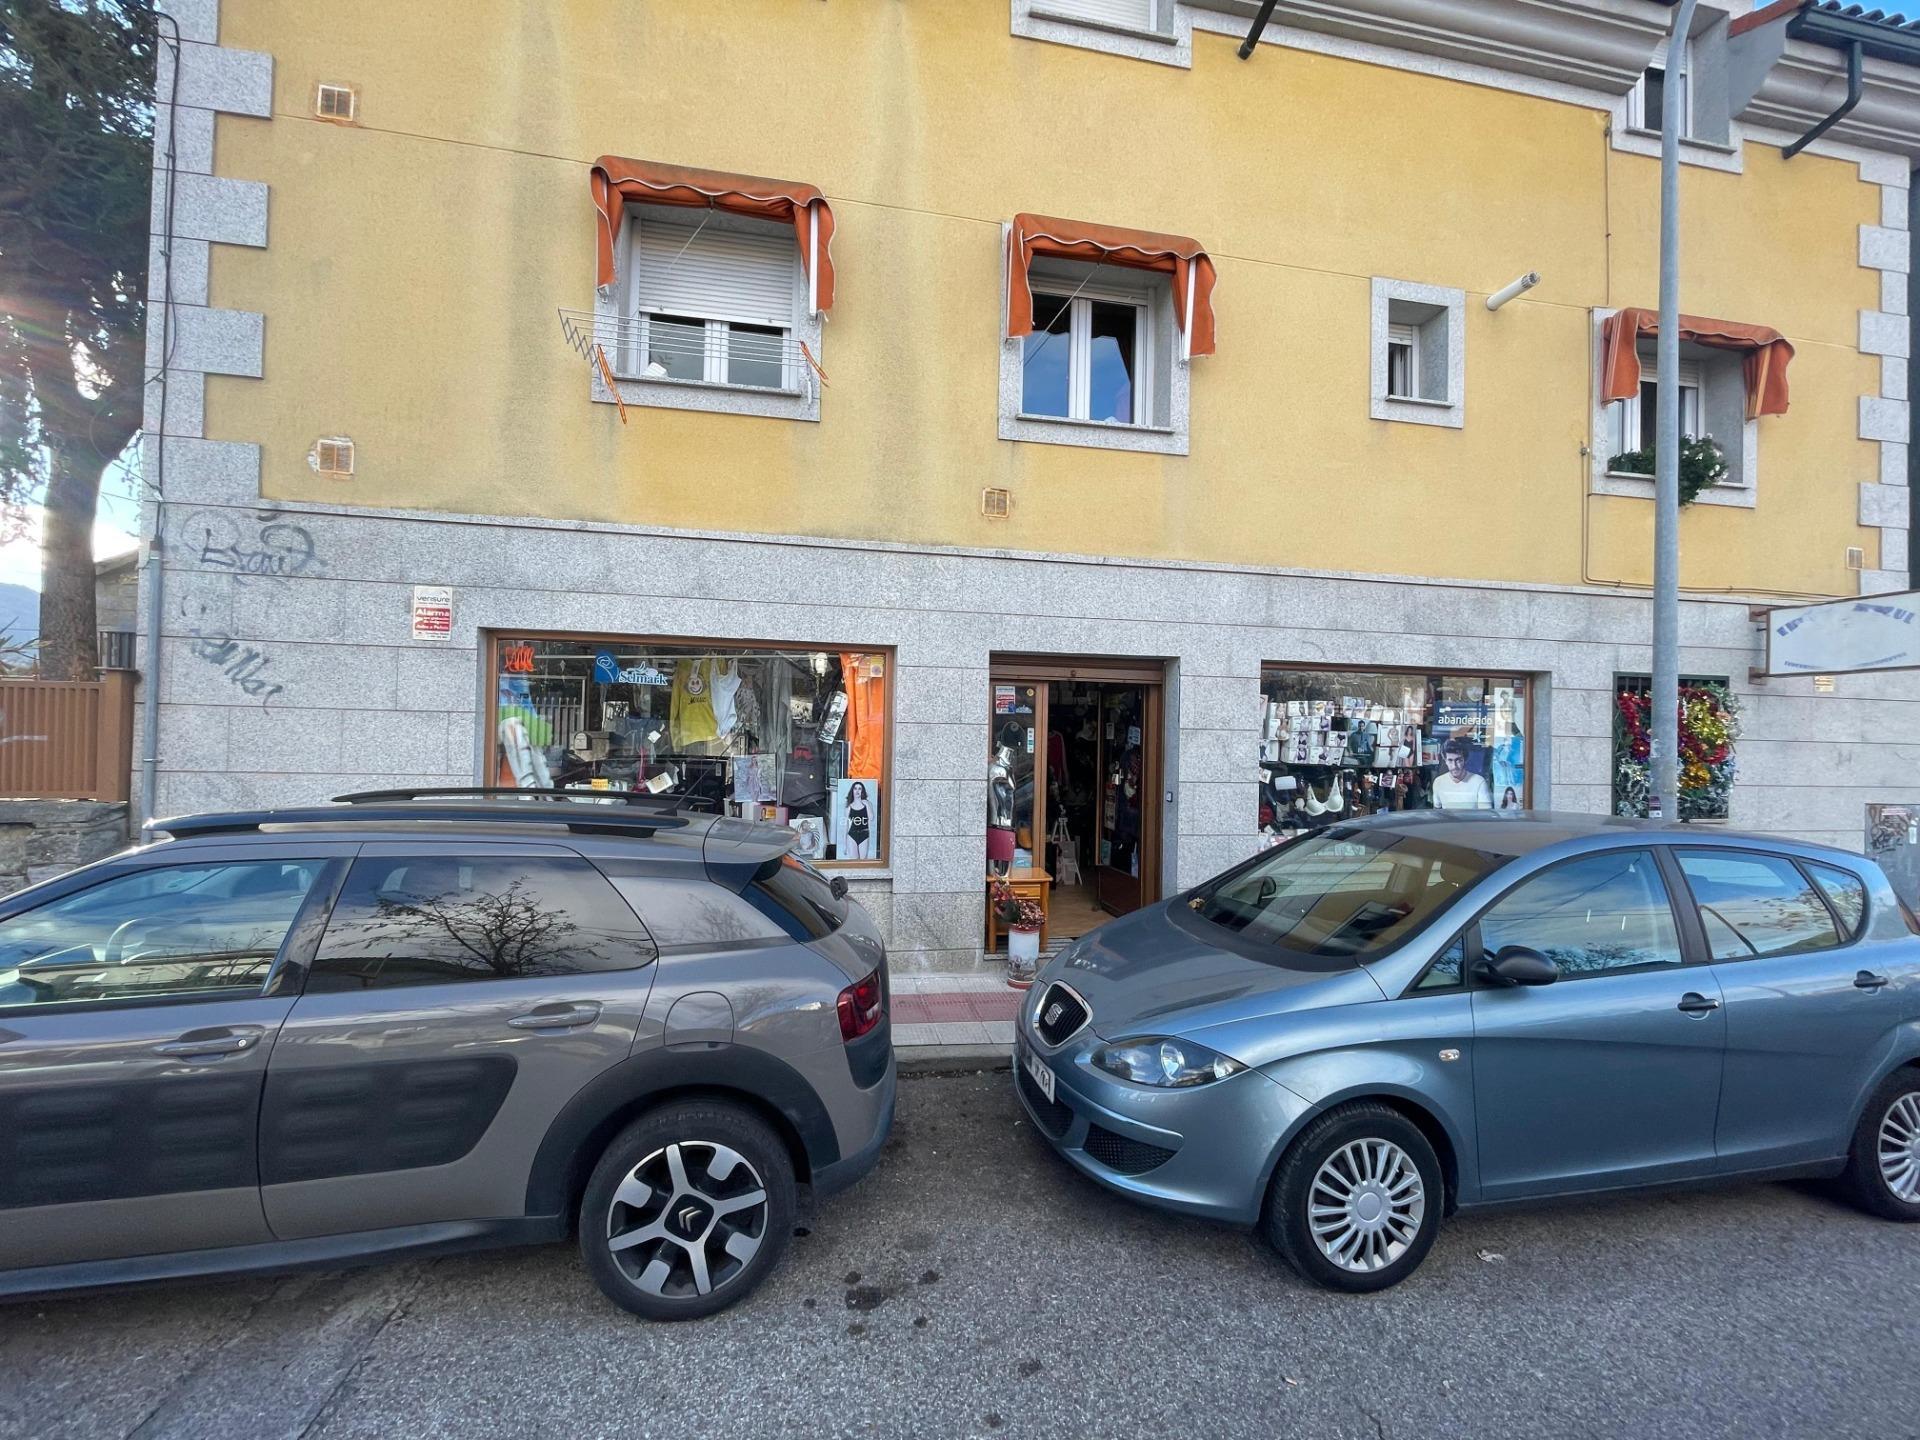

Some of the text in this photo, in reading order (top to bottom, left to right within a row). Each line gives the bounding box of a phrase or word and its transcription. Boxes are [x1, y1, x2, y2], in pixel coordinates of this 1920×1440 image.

[416, 608, 449, 617] Alarma
[619, 671, 668, 685] Selmark
[1438, 714, 1492, 725] abanderado
